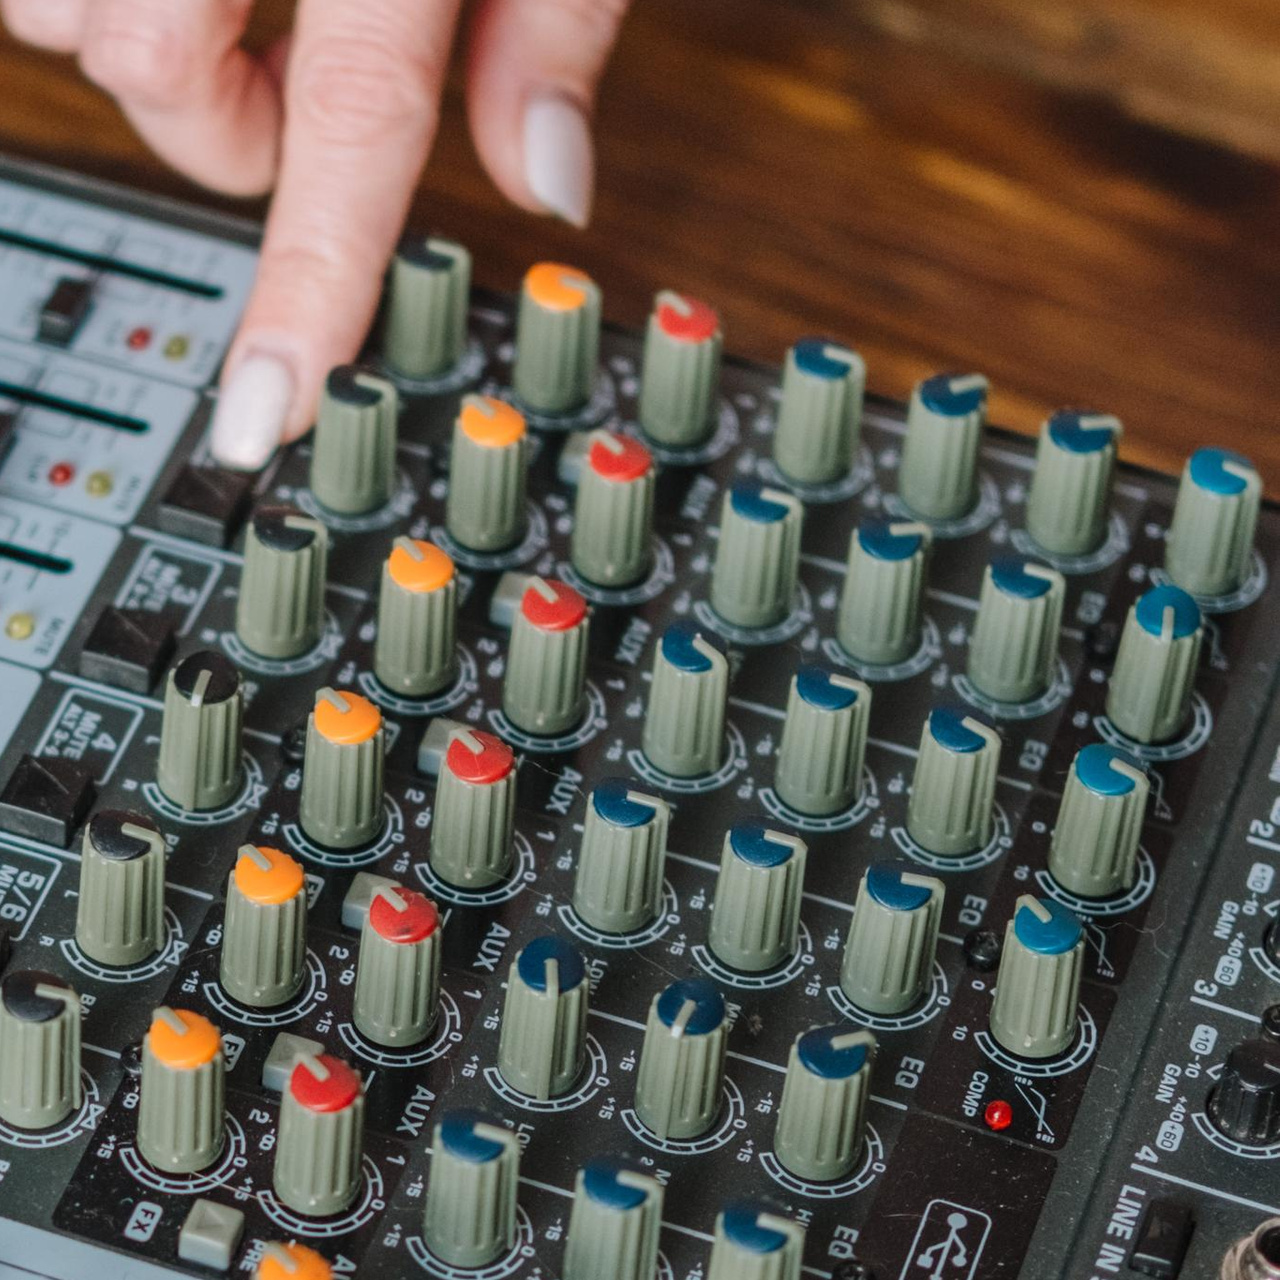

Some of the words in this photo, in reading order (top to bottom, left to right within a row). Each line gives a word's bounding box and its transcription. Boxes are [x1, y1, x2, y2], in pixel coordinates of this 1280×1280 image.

[35, 617, 64, 656] MUTE
[615, 616, 652, 665] AUX
[61, 703, 83, 731] ALT
[62, 711, 102, 760] MUTE
[91, 732, 117, 753] 4
[1020, 739, 1050, 771] EQ
[122, 778, 138, 792] R
[405, 788, 425, 804] 2
[545, 766, 583, 815] AUX
[261, 813, 281, 835] +15
[870, 815, 887, 840] +15
[1249, 819, 1275, 839] 2
[392, 850, 412, 874] +15
[1252, 864, 1268, 892] +10
[0, 871, 47, 923] 5/6
[535, 892, 554, 917] +15
[689, 888, 707, 910] -15
[958, 893, 988, 926] EQ
[1241, 891, 1260, 916] -10
[1213, 900, 1240, 941] GAIN
[39, 934, 56, 948] R
[472, 921, 513, 972] AUX
[669, 932, 688, 957] +15
[824, 927, 841, 951] -15
[1227, 932, 1246, 960] +40
[329, 945, 350, 960] 2
[182, 969, 200, 993] +15
[1218, 958, 1237, 985] +60
[464, 989, 482, 1001] 1
[805, 972, 822, 998] +15
[1194, 979, 1219, 998] 3
[316, 1010, 335, 1034] +15
[483, 1008, 500, 1031] -15
[952, 1024, 969, 1042] 10
[1194, 1027, 1212, 1053] +10
[461, 1054, 480, 1079] +15
[619, 1049, 637, 1073] -15
[895, 1054, 926, 1089] EQ
[1184, 1054, 1202, 1080] -10
[964, 1070, 990, 1118] COMP
[1154, 1063, 1182, 1104] GAIN
[396, 1084, 436, 1137] AUX
[598, 1096, 617, 1121] +15
[755, 1091, 773, 1115] -15
[1169, 1095, 1188, 1123] +40
[248, 1108, 271, 1125] 2
[97, 1134, 117, 1160] +15
[1160, 1124, 1178, 1151] +60
[233, 1156, 248, 1169] 0
[386, 1154, 405, 1167] 1
[736, 1138, 754, 1164] +15
[1134, 1144, 1159, 1164] 4
[234, 1176, 254, 1202] +15
[406, 1175, 424, 1199] -15
[131, 1207, 157, 1235] FX
[1106, 1184, 1148, 1241] LINE
[382, 1222, 402, 1249] +15
[545, 1217, 564, 1242] -15
[827, 1224, 860, 1260] EQ
[239, 1238, 269, 1272] PRE
[1095, 1243, 1127, 1273] IN
